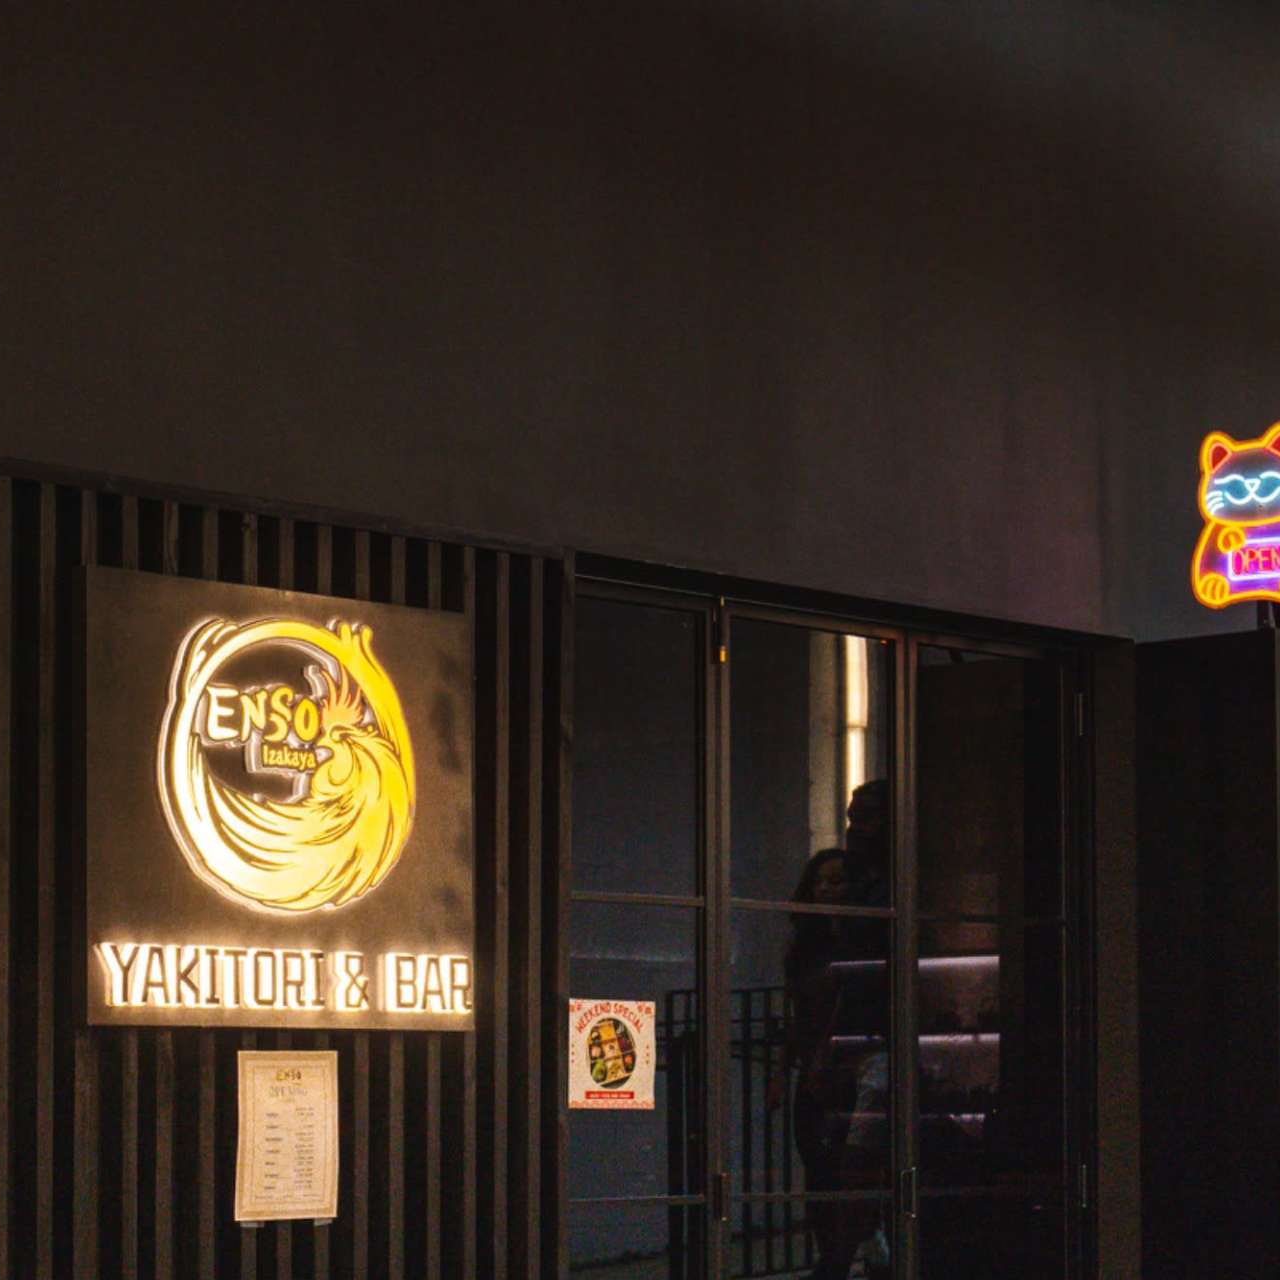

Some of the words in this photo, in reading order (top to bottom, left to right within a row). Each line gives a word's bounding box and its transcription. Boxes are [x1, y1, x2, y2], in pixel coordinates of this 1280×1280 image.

[206, 685, 319, 743] ENSO
[262, 745, 317, 770] Izakaya
[98, 942, 325, 1008] YAKITORI
[333, 949, 370, 1011] &
[381, 950, 473, 1015] BAR
